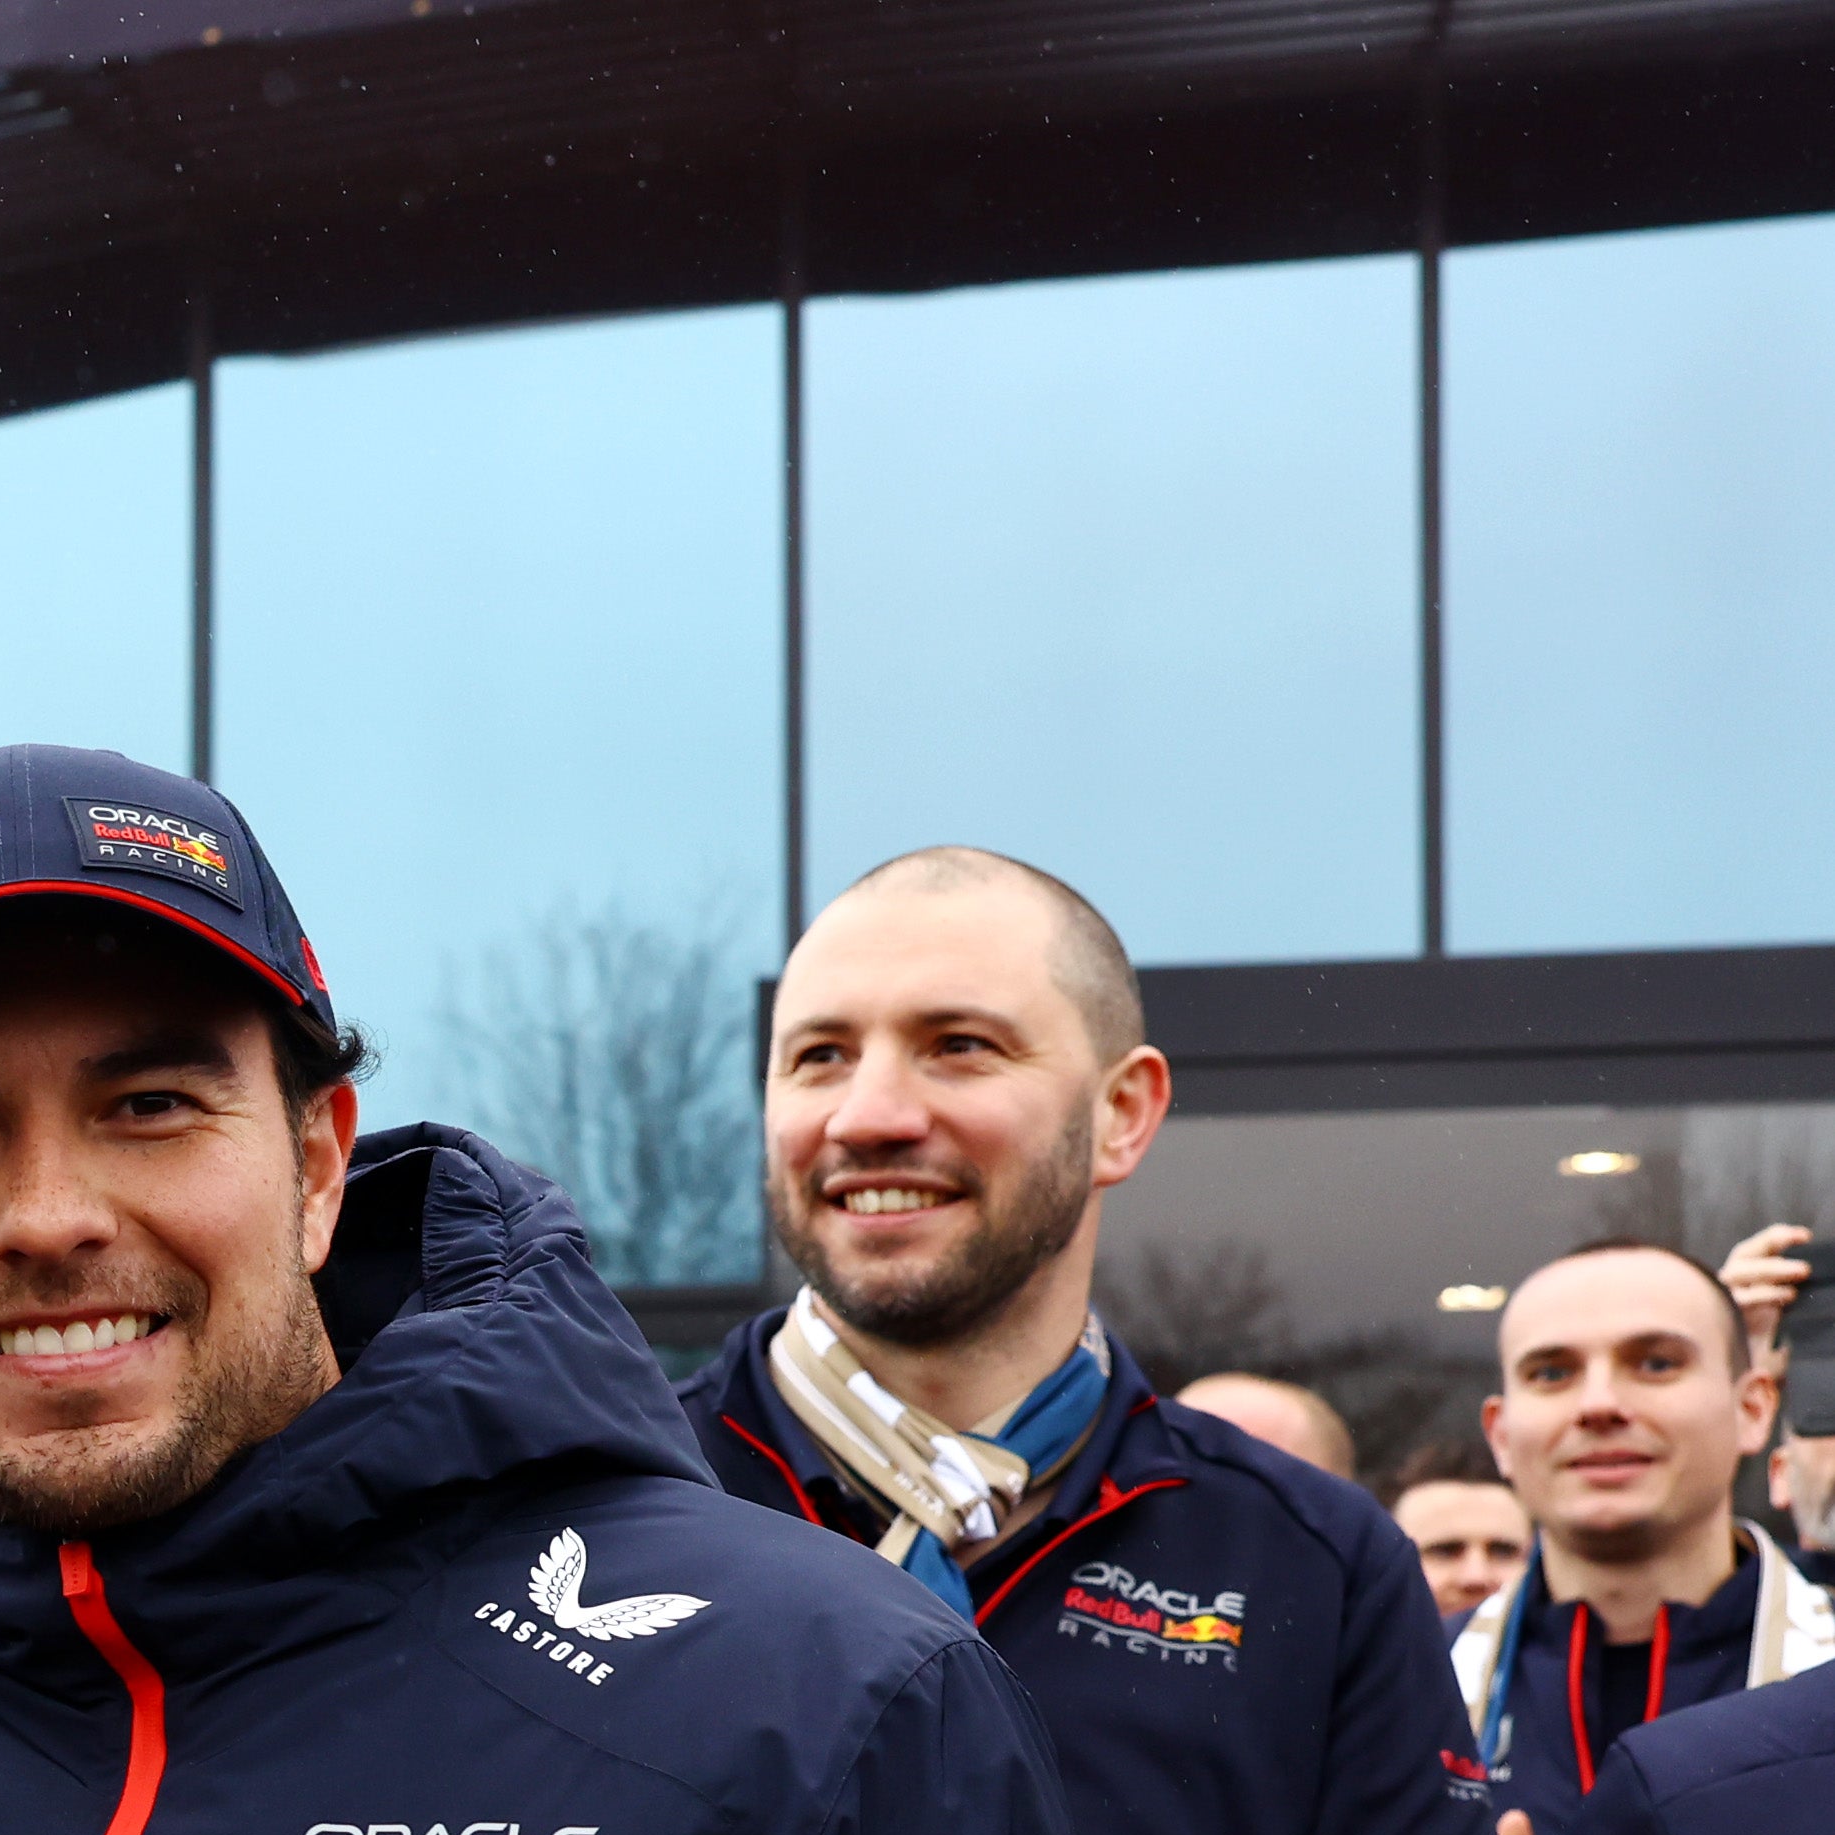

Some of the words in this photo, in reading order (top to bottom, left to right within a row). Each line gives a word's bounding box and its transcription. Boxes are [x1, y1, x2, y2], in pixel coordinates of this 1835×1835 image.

[88, 806, 219, 851] ORACLE
[93, 823, 132, 840] Red
[134, 828, 171, 847] Bull
[99, 845, 228, 888] RACING
[1071, 1561, 1246, 1618] ORACLE
[473, 1602, 615, 1687] CASTORE
